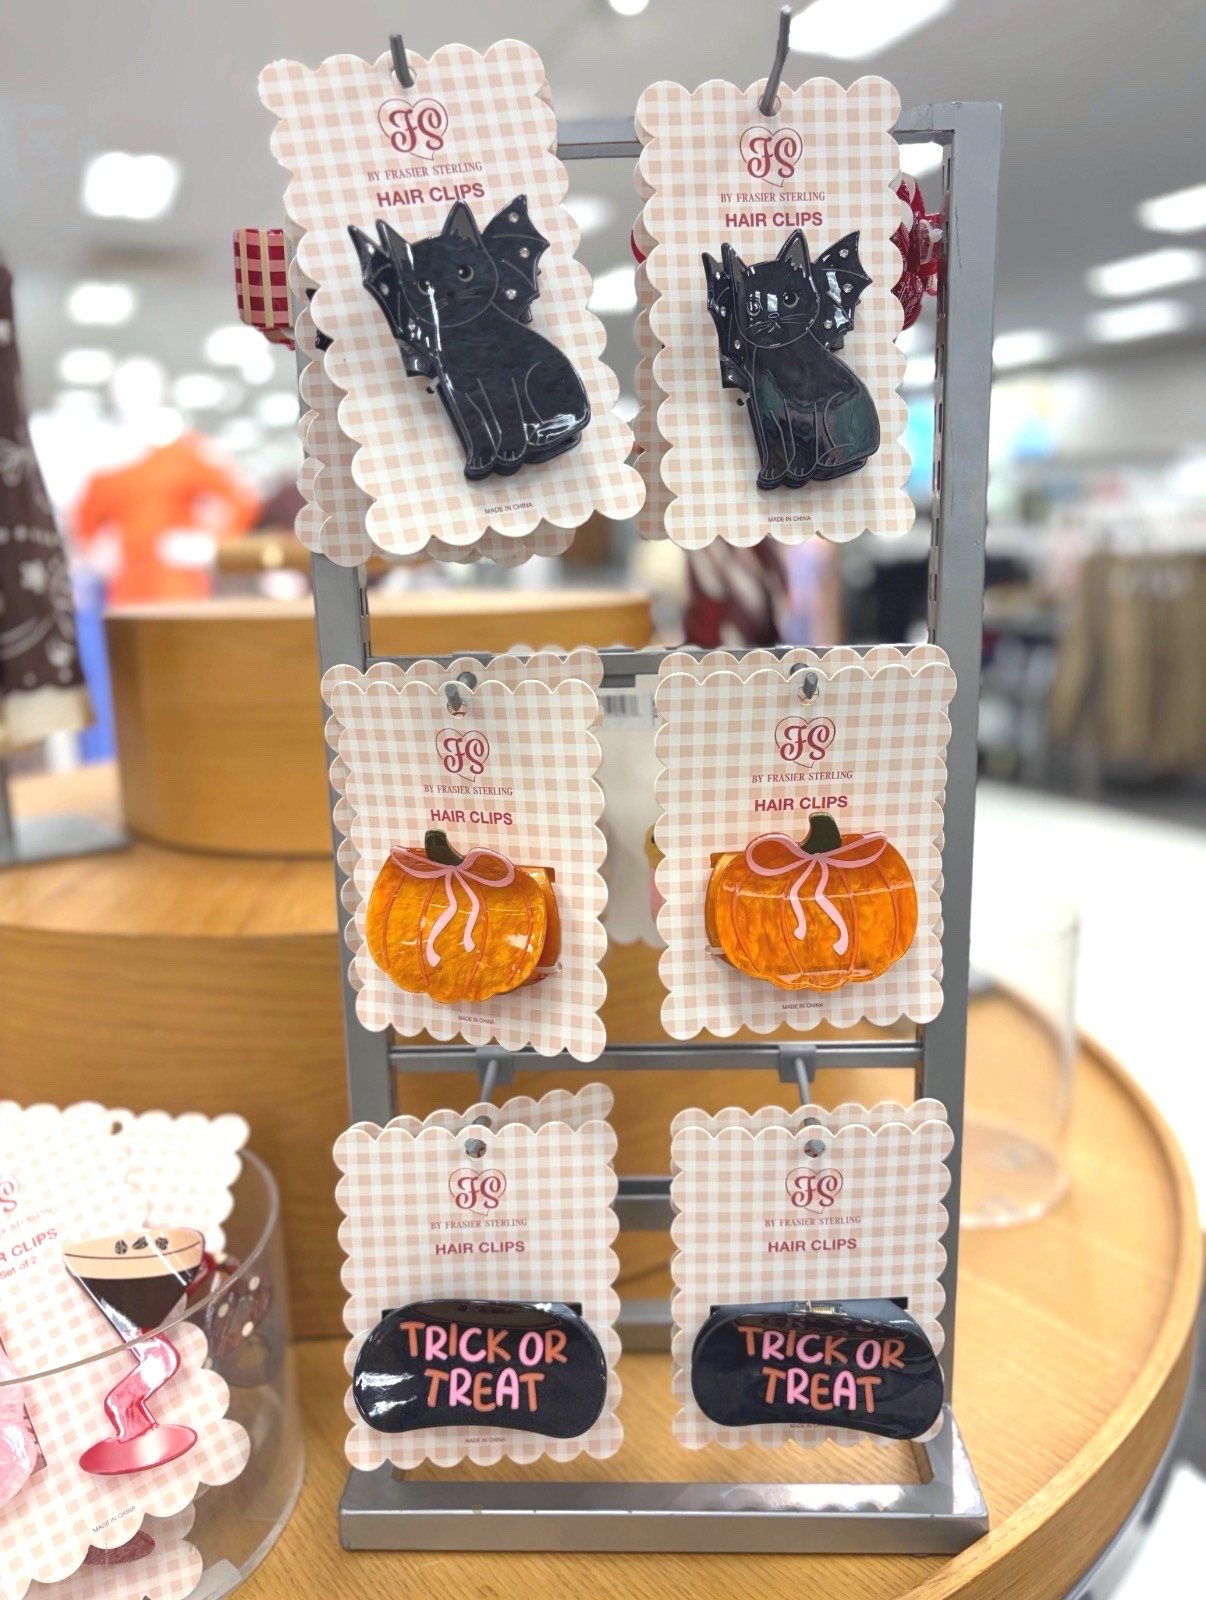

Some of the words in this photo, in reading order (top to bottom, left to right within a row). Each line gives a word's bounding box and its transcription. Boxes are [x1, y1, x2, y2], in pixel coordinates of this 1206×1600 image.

[367, 171, 381, 182] BY
[385, 167, 429, 180] FRASIER
[432, 161, 483, 176] STERLING
[376, 189, 425, 207] HAIR
[429, 183, 485, 201] CLIPS
[720, 193, 732, 203] BY
[736, 192, 776, 202] FRASIER
[779, 191, 826, 201] STERLING
[725, 213, 767, 227] HAIR
[772, 211, 823, 227] CLIPS
[484, 506, 503, 514] MADE
[512, 502, 533, 510] CHINA
[752, 775, 763, 783] BY
[767, 773, 805, 782] FRASIER
[808, 771, 853, 781] STERLING
[424, 784, 434, 793] BY
[437, 785, 470, 794] FRASIER
[473, 786, 513, 796] STERLING
[754, 798, 794, 812] HAIR
[799, 795, 848, 809] CLIPS
[430, 809, 466, 822] HAIR
[469, 811, 513, 825] CLIPS
[430, 1221, 441, 1229] BY
[445, 1219, 482, 1229] FRASIER
[484, 1218, 528, 1227] STERLING
[765, 1219, 776, 1227] BY
[779, 1217, 816, 1227] FRASIER
[818, 1216, 861, 1225] STERLING
[11, 1228, 58, 1257] CLIPS
[435, 1243, 474, 1255] HAIR
[478, 1241, 525, 1253] CLIPS
[768, 1240, 806, 1253] HAIR
[811, 1238, 857, 1251] CLIPS
[400, 1321, 511, 1364] TRICK
[518, 1329, 568, 1366] OR
[737, 1326, 849, 1366] TRICK
[855, 1338, 906, 1370] OR
[424, 1367, 545, 1412] TREAT
[762, 1366, 882, 1414] TREAT
[92, 1520, 110, 1533] MADE
[110, 1516, 117, 1524] IN
[117, 1506, 136, 1519] CHINA
